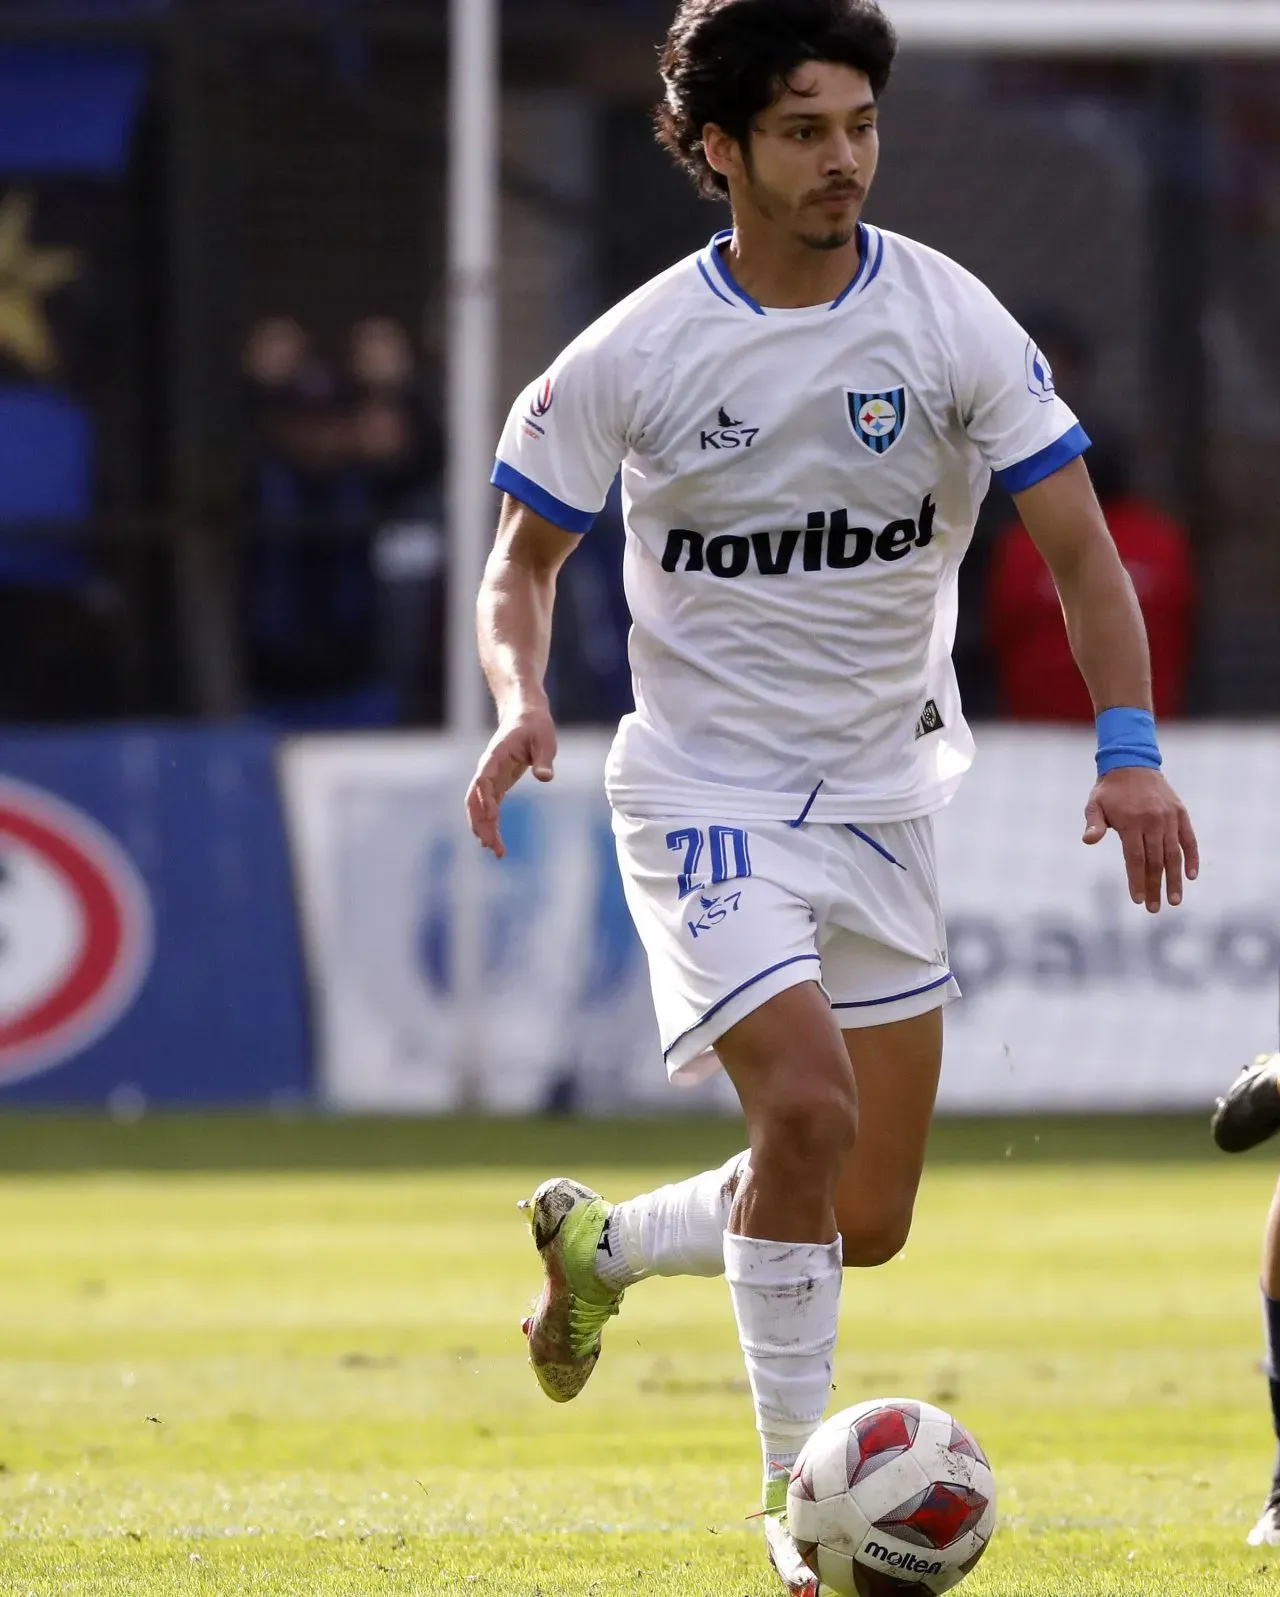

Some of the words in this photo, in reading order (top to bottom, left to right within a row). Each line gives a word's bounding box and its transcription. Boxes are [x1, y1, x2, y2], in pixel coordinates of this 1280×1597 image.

[700, 428, 759, 450] KS7
[660, 493, 937, 578] novibet
[665, 825, 752, 900] 20
[688, 891, 742, 938] KS7
[864, 1541, 943, 1575] molten
